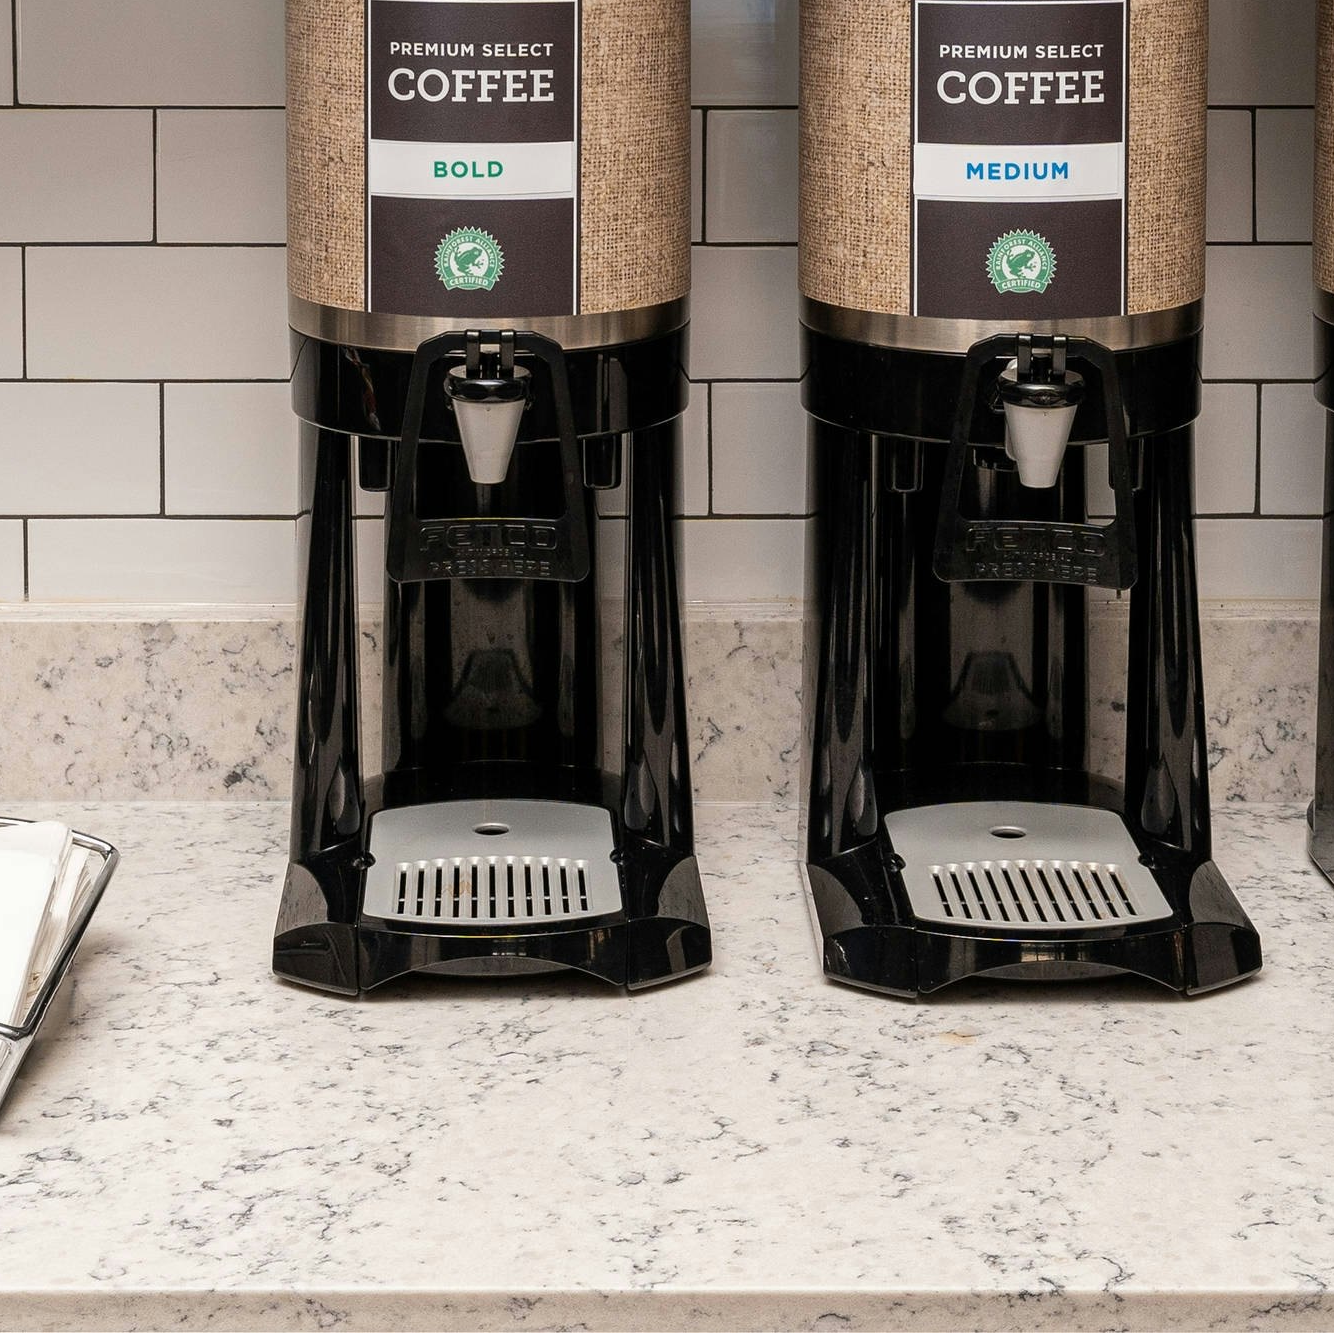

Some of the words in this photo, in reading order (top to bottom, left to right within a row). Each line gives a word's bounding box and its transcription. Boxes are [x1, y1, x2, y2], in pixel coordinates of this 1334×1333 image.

[390, 42, 474, 57] PREMIUM
[482, 43, 554, 57] SELECT
[939, 44, 1028, 59] PREMIUM
[1035, 44, 1104, 59] SELECT
[388, 68, 554, 102] COFFEE
[936, 70, 1104, 105] COFFEE
[434, 161, 504, 178] BOLD
[966, 162, 1069, 180] MEDIUM
[449, 277, 488, 286] CERTIFIED
[1002, 280, 1041, 288] CERTIFIED
